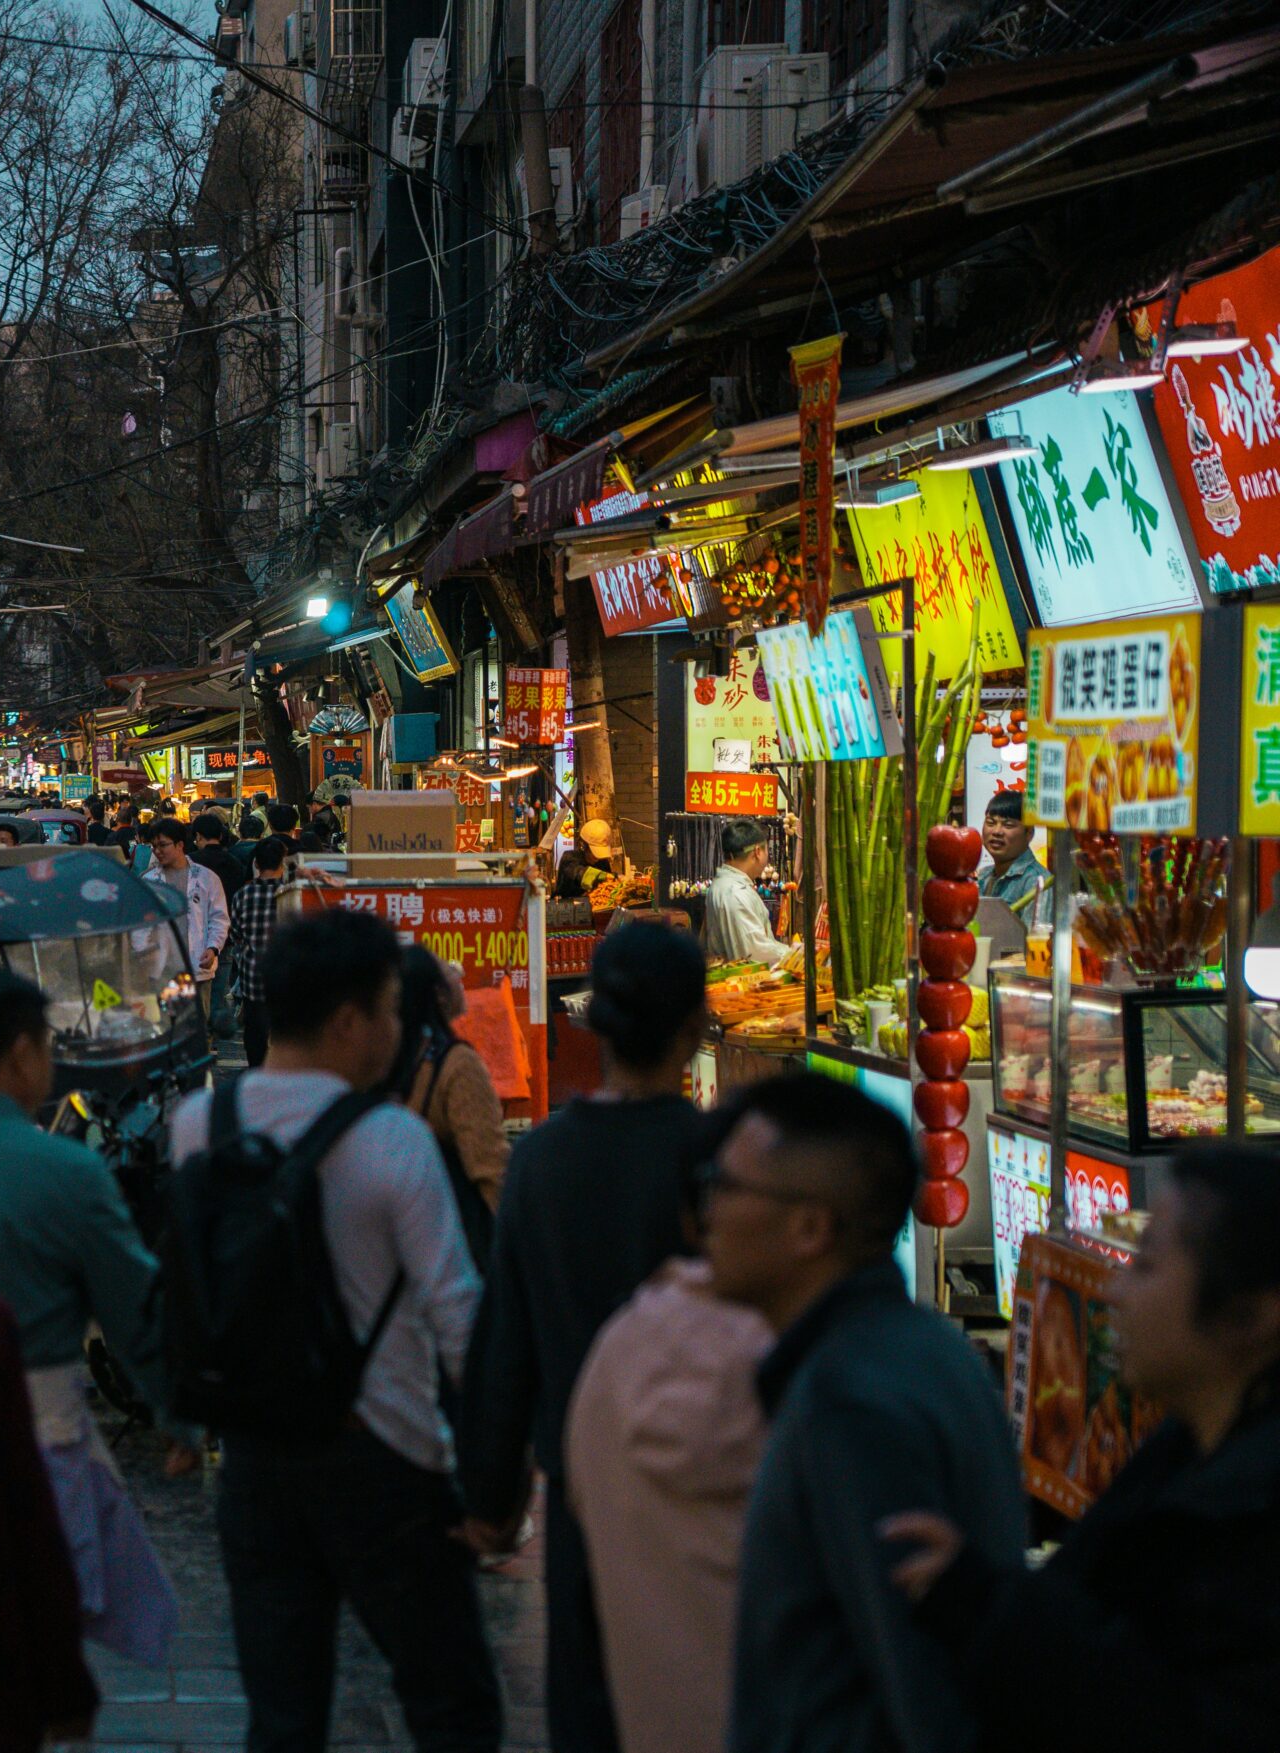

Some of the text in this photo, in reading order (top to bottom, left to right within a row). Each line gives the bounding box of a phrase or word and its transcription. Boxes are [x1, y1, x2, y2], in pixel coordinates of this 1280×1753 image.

[507, 686, 540, 711] 彩果
[542, 686, 566, 711] 彩果
[689, 778, 775, 809] 全场5元一个起
